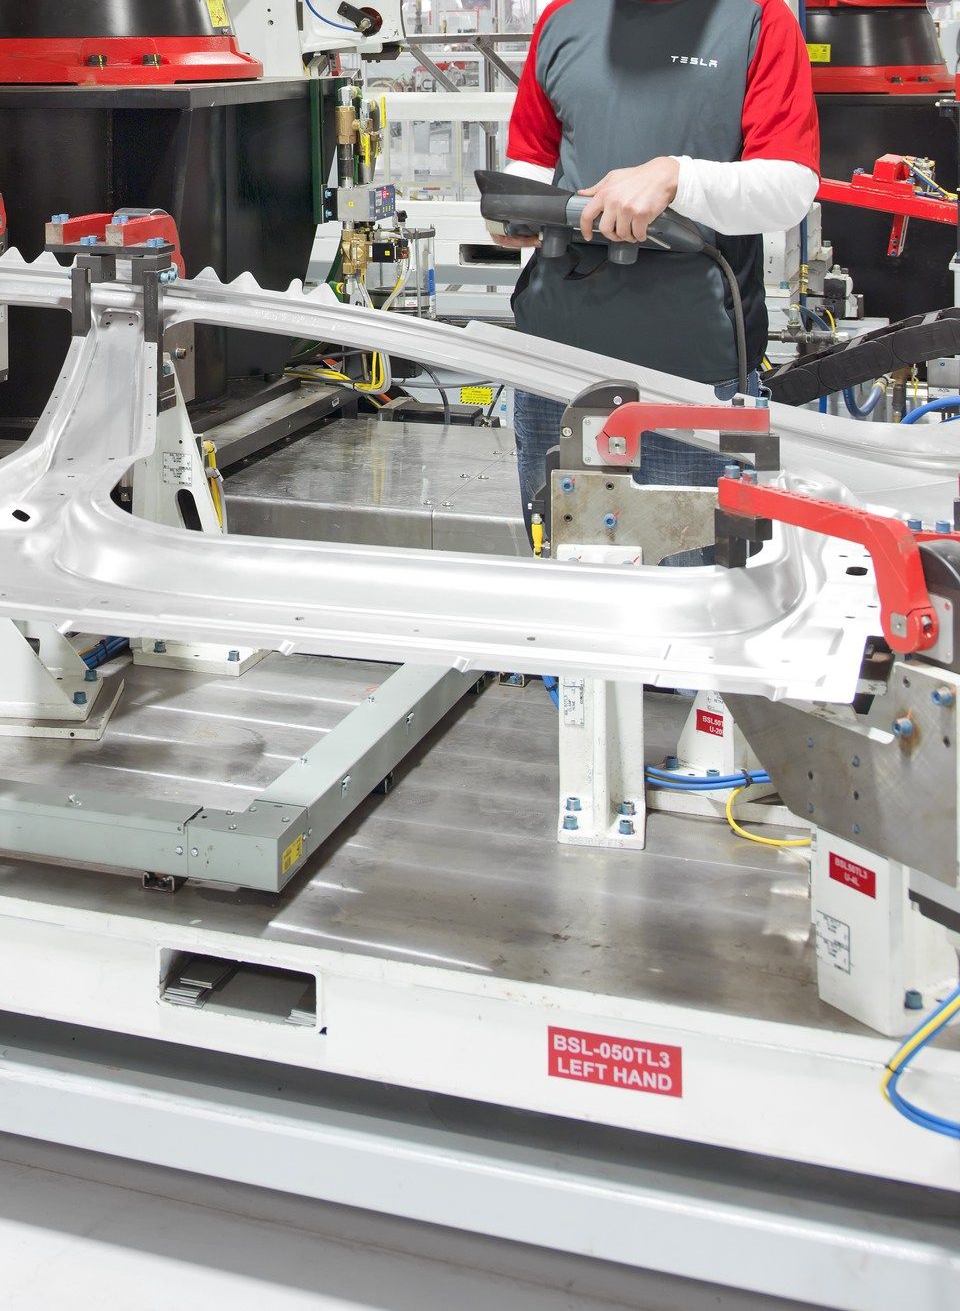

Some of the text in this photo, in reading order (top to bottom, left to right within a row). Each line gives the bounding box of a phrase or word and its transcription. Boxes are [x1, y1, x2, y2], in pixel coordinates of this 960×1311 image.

[670, 55, 718, 68] TESLA
[553, 1034, 671, 1069] BSL-050TL3
[557, 1056, 673, 1090] LEFT HAND
